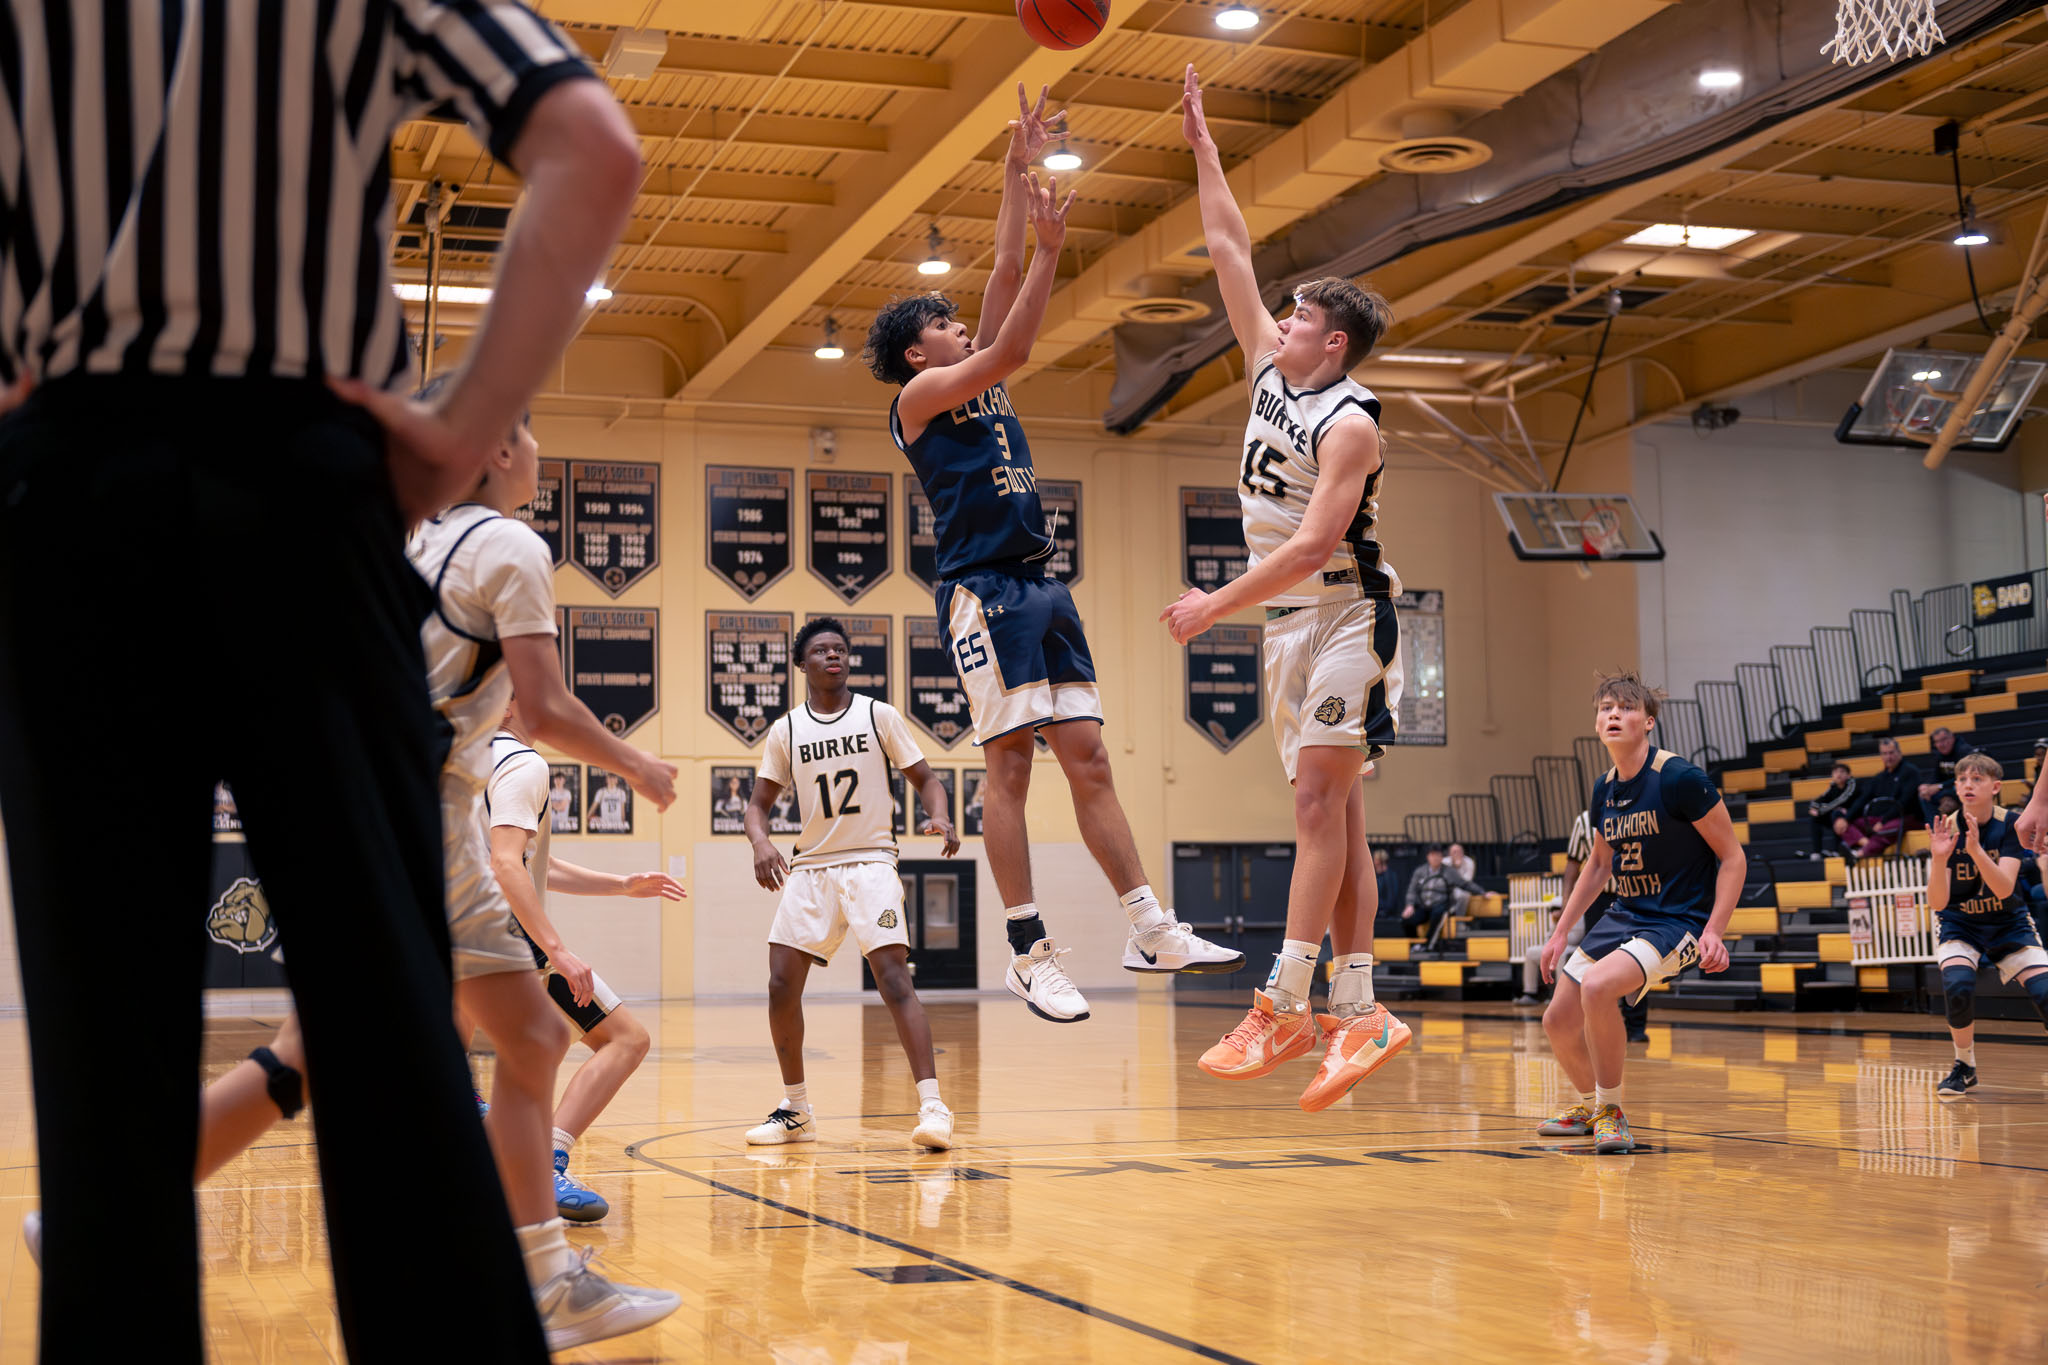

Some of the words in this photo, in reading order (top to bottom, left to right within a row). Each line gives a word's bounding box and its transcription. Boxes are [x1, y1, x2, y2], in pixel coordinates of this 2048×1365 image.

[994, 422, 1012, 461] 3
[991, 466, 1037, 497] SOUTH
[1242, 439, 1288, 499] 15
[1997, 582, 2032, 610] BAND
[582, 612, 608, 625] GIRLS
[611, 612, 646, 625] SOCCER
[956, 631, 989, 675] ES
[798, 733, 870, 765] BURKE
[814, 768, 861, 820] 12
[1604, 809, 1660, 842] ELKHORN
[1620, 842, 1644, 871] 23
